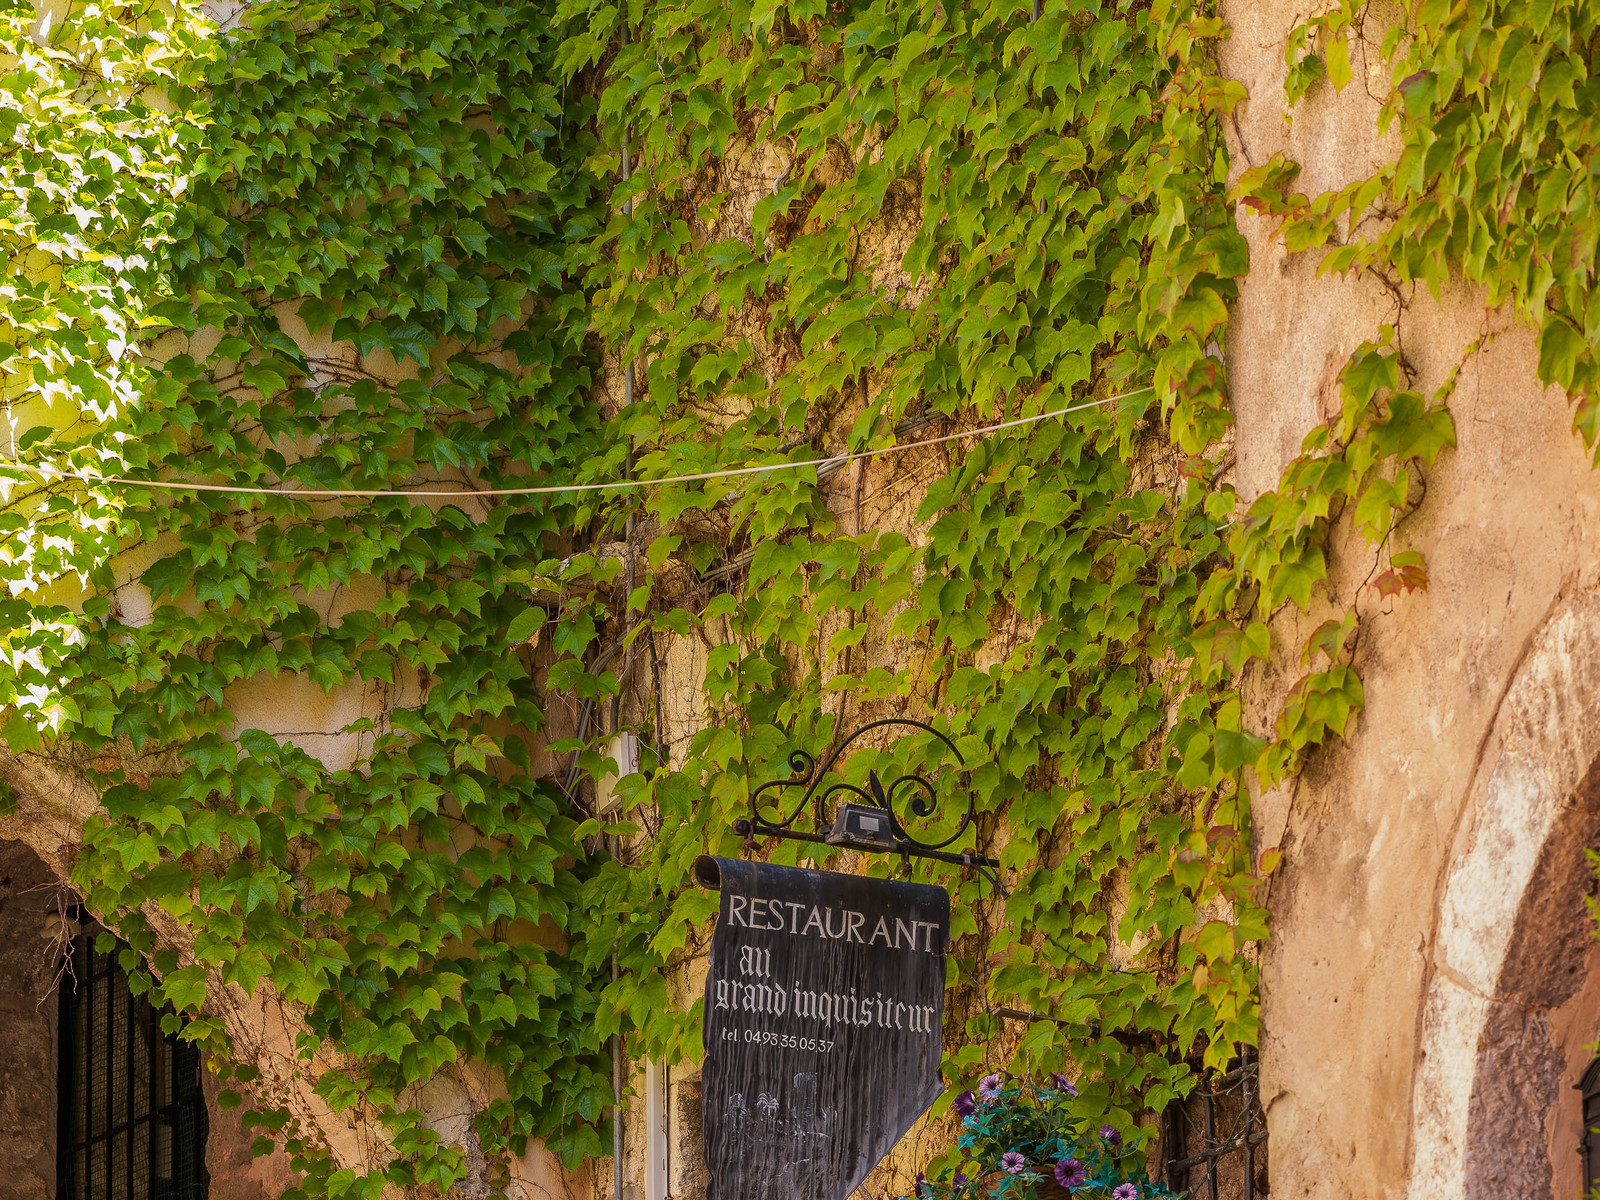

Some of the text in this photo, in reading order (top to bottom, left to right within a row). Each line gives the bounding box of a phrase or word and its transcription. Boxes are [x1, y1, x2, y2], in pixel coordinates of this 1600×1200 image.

[727, 894, 940, 953] RESTAURANT
[739, 944, 771, 978] au
[714, 978, 936, 1033] grand inquisiteur
[744, 1029, 835, 1053] 04.93.35.05.37
